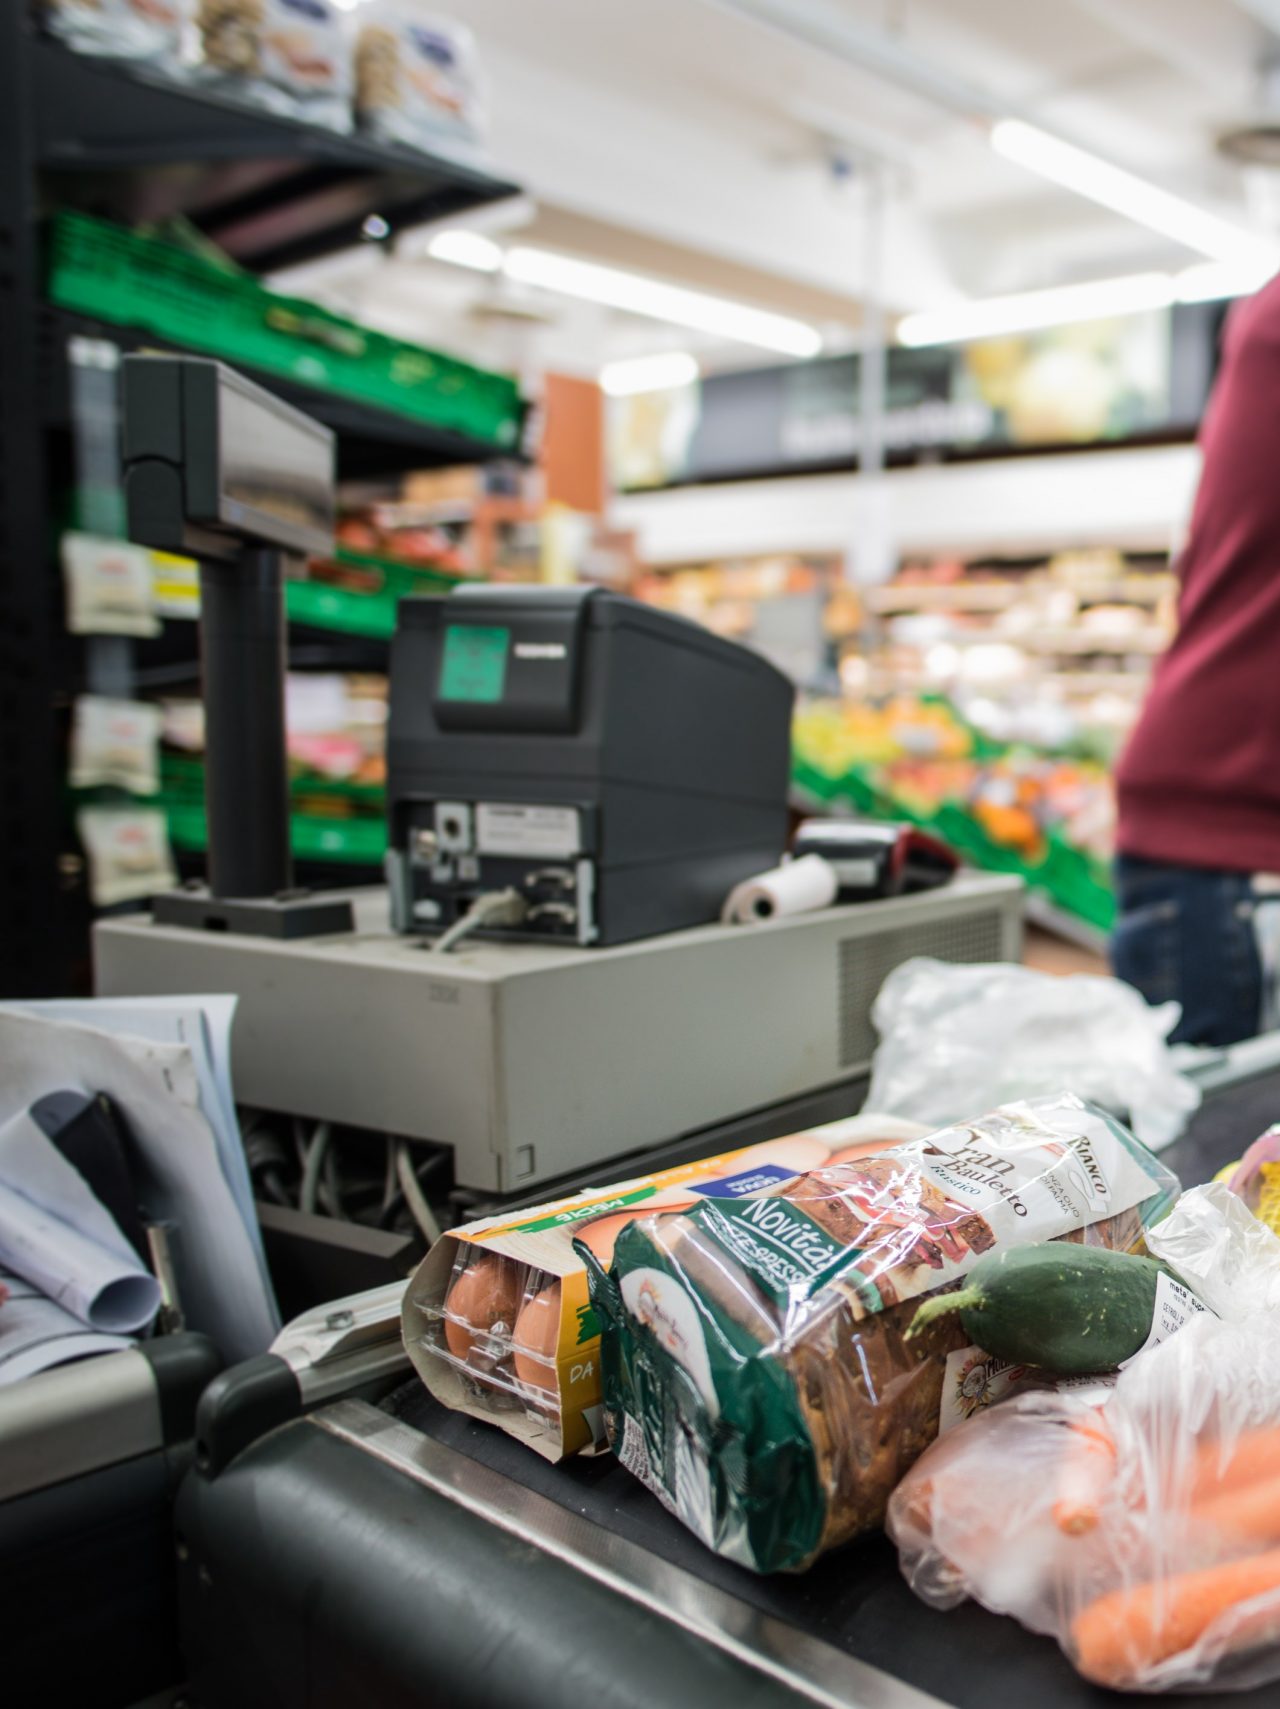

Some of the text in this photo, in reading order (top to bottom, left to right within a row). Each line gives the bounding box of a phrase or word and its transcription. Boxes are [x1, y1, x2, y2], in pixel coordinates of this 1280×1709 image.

[929, 1165, 981, 1195] Rustico
[1066, 1136, 1107, 1194] BIANCO
[940, 1159, 1028, 1217] Bauletto
[1048, 1185, 1070, 1215] PALMA
[554, 1198, 625, 1222] MEDIE
[1063, 1195, 1080, 1218] OLIO
[570, 1360, 594, 1384] DA
